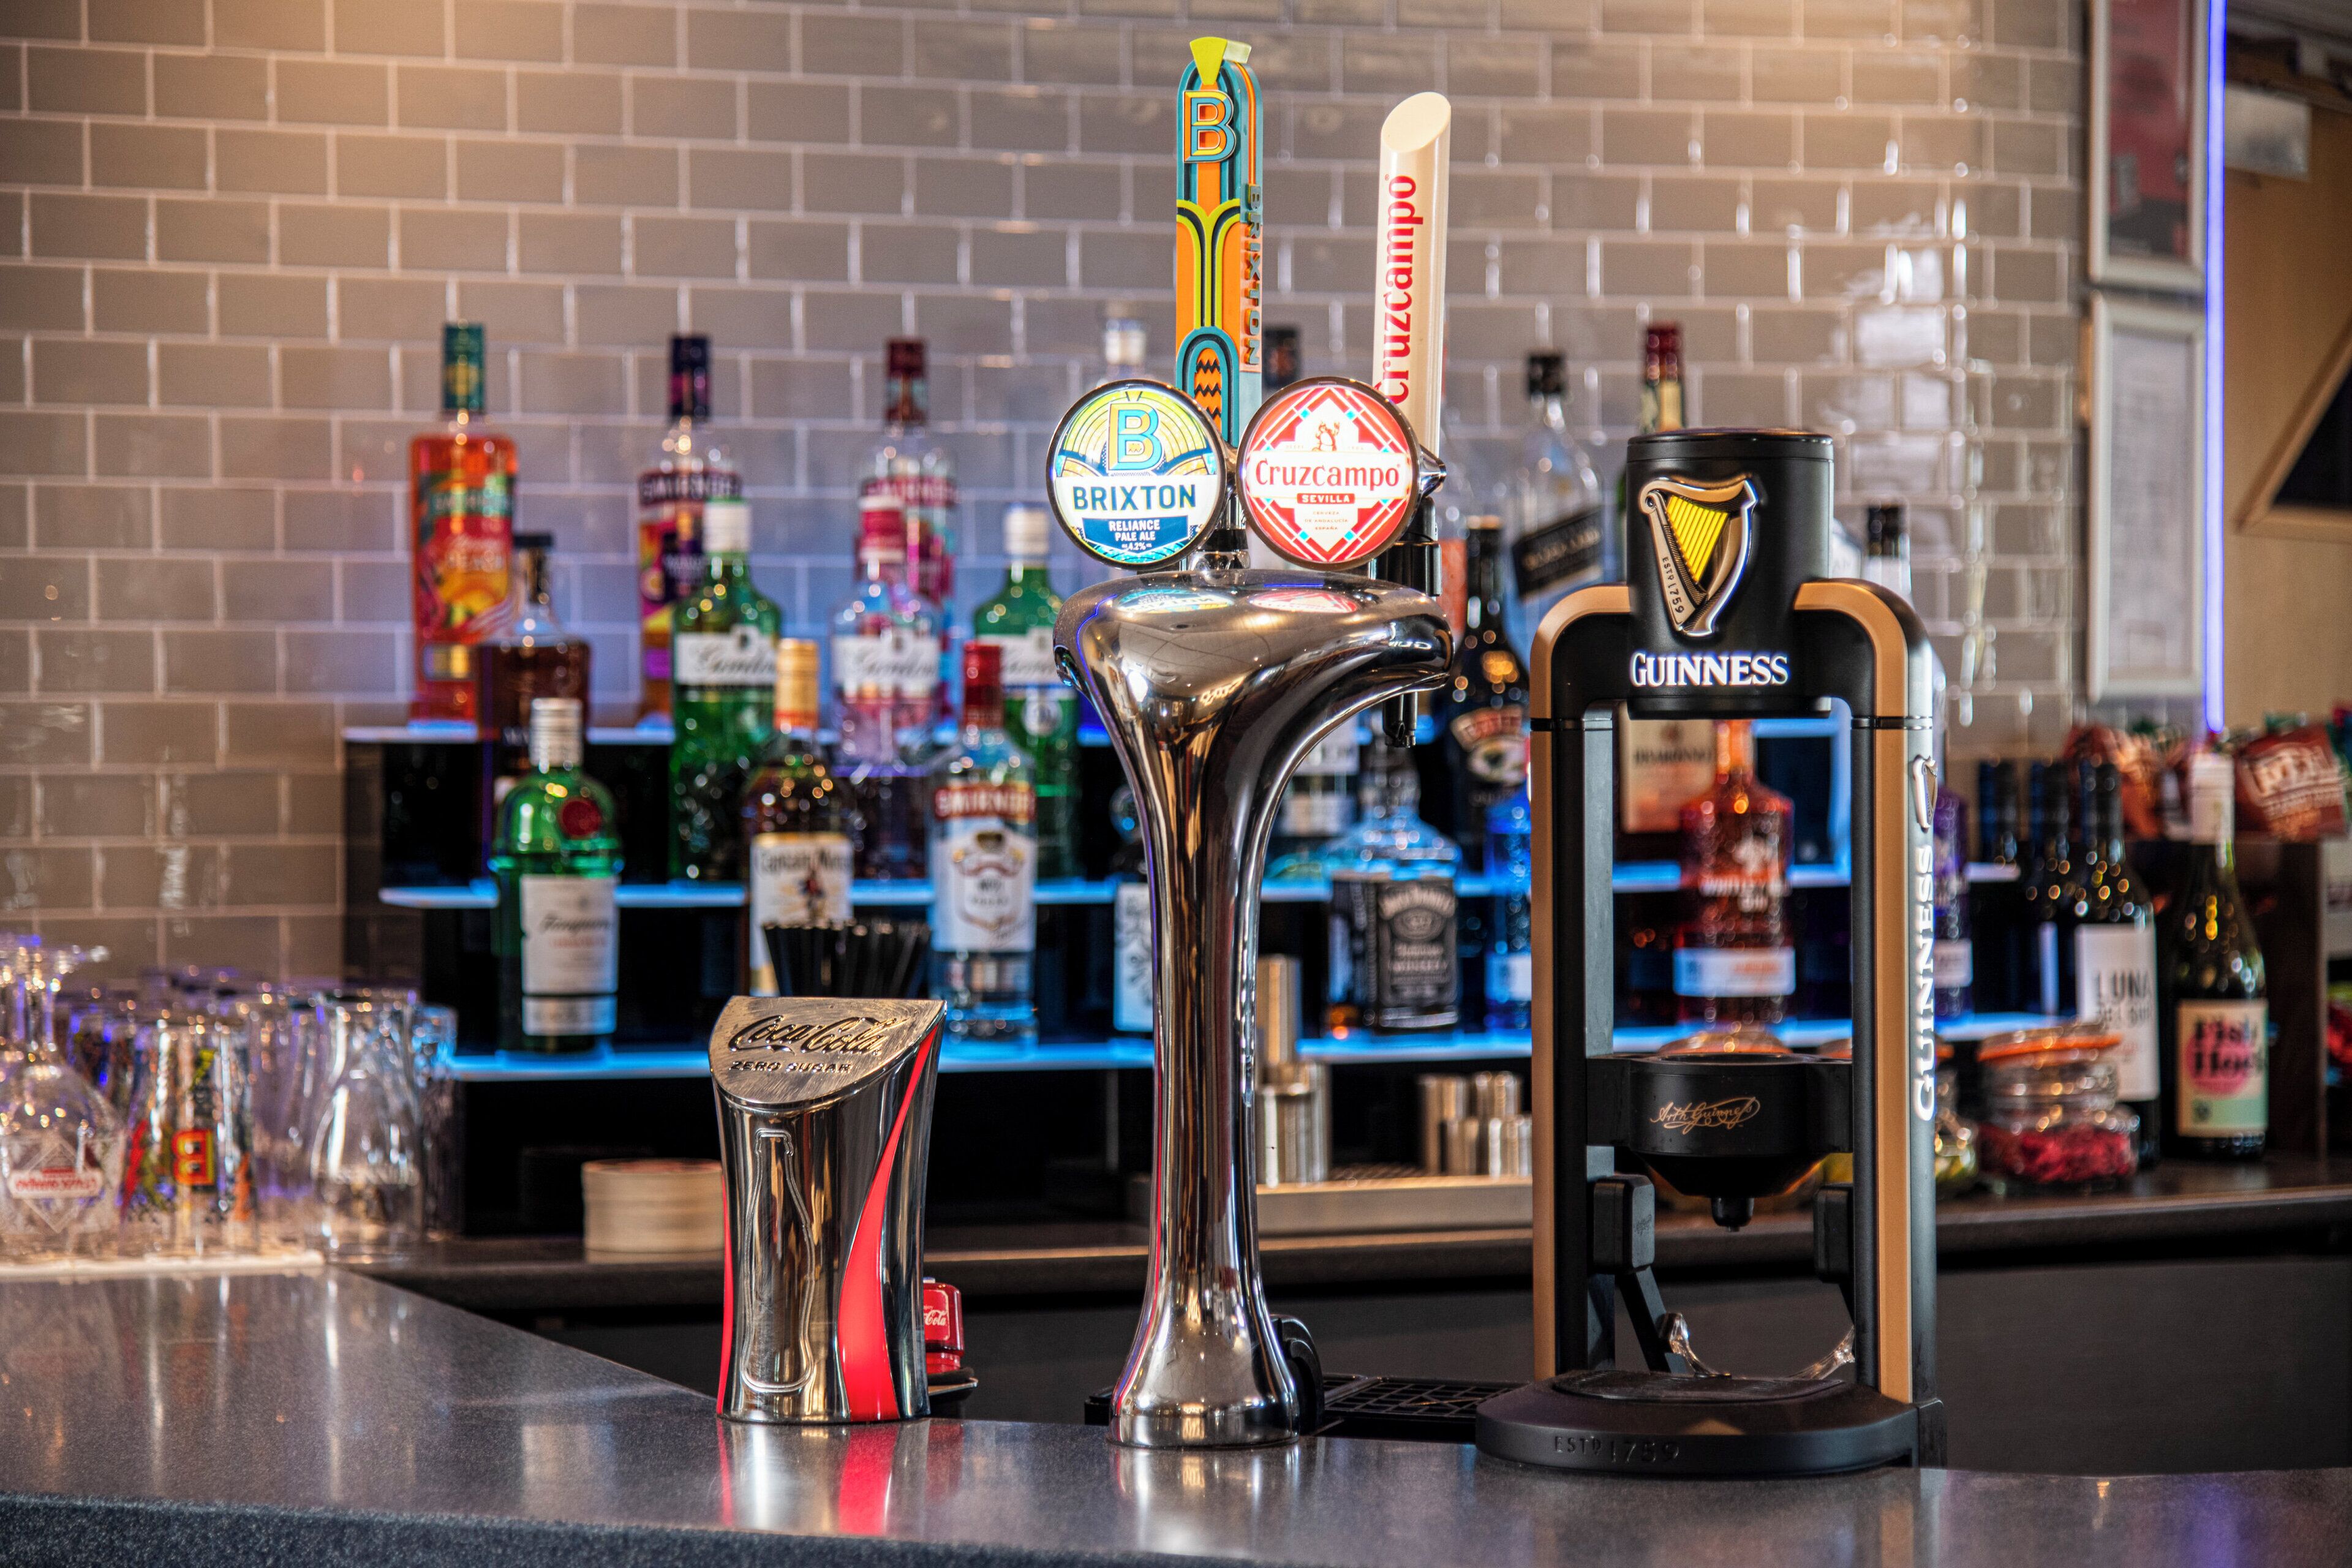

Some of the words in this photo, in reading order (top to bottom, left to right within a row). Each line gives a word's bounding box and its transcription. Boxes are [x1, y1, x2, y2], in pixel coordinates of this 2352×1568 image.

[1183, 90, 1237, 164] B
[1245, 183, 1262, 366] BRIXTON
[1374, 175, 1423, 405] Cruzcampo
[1108, 401, 1163, 471] B
[1256, 458, 1400, 491] Cruzcampo
[1072, 484, 1196, 511] BRIXTON
[1302, 494, 1351, 503] SEVILLA
[1109, 519, 1161, 532] RELIANCE
[1115, 532, 1137, 541] PALE
[1139, 531, 1156, 541] ALE
[1129, 542, 1146, 551] 4.2%
[1667, 582, 1685, 614] 1759
[1630, 650, 1790, 687] GUINNESS
[1914, 843, 1936, 1122] GUINNESS
[728, 1014, 910, 1057] Coca-Cola
[728, 1060, 782, 1072] ZERO
[785, 1061, 853, 1074] SUGAR
